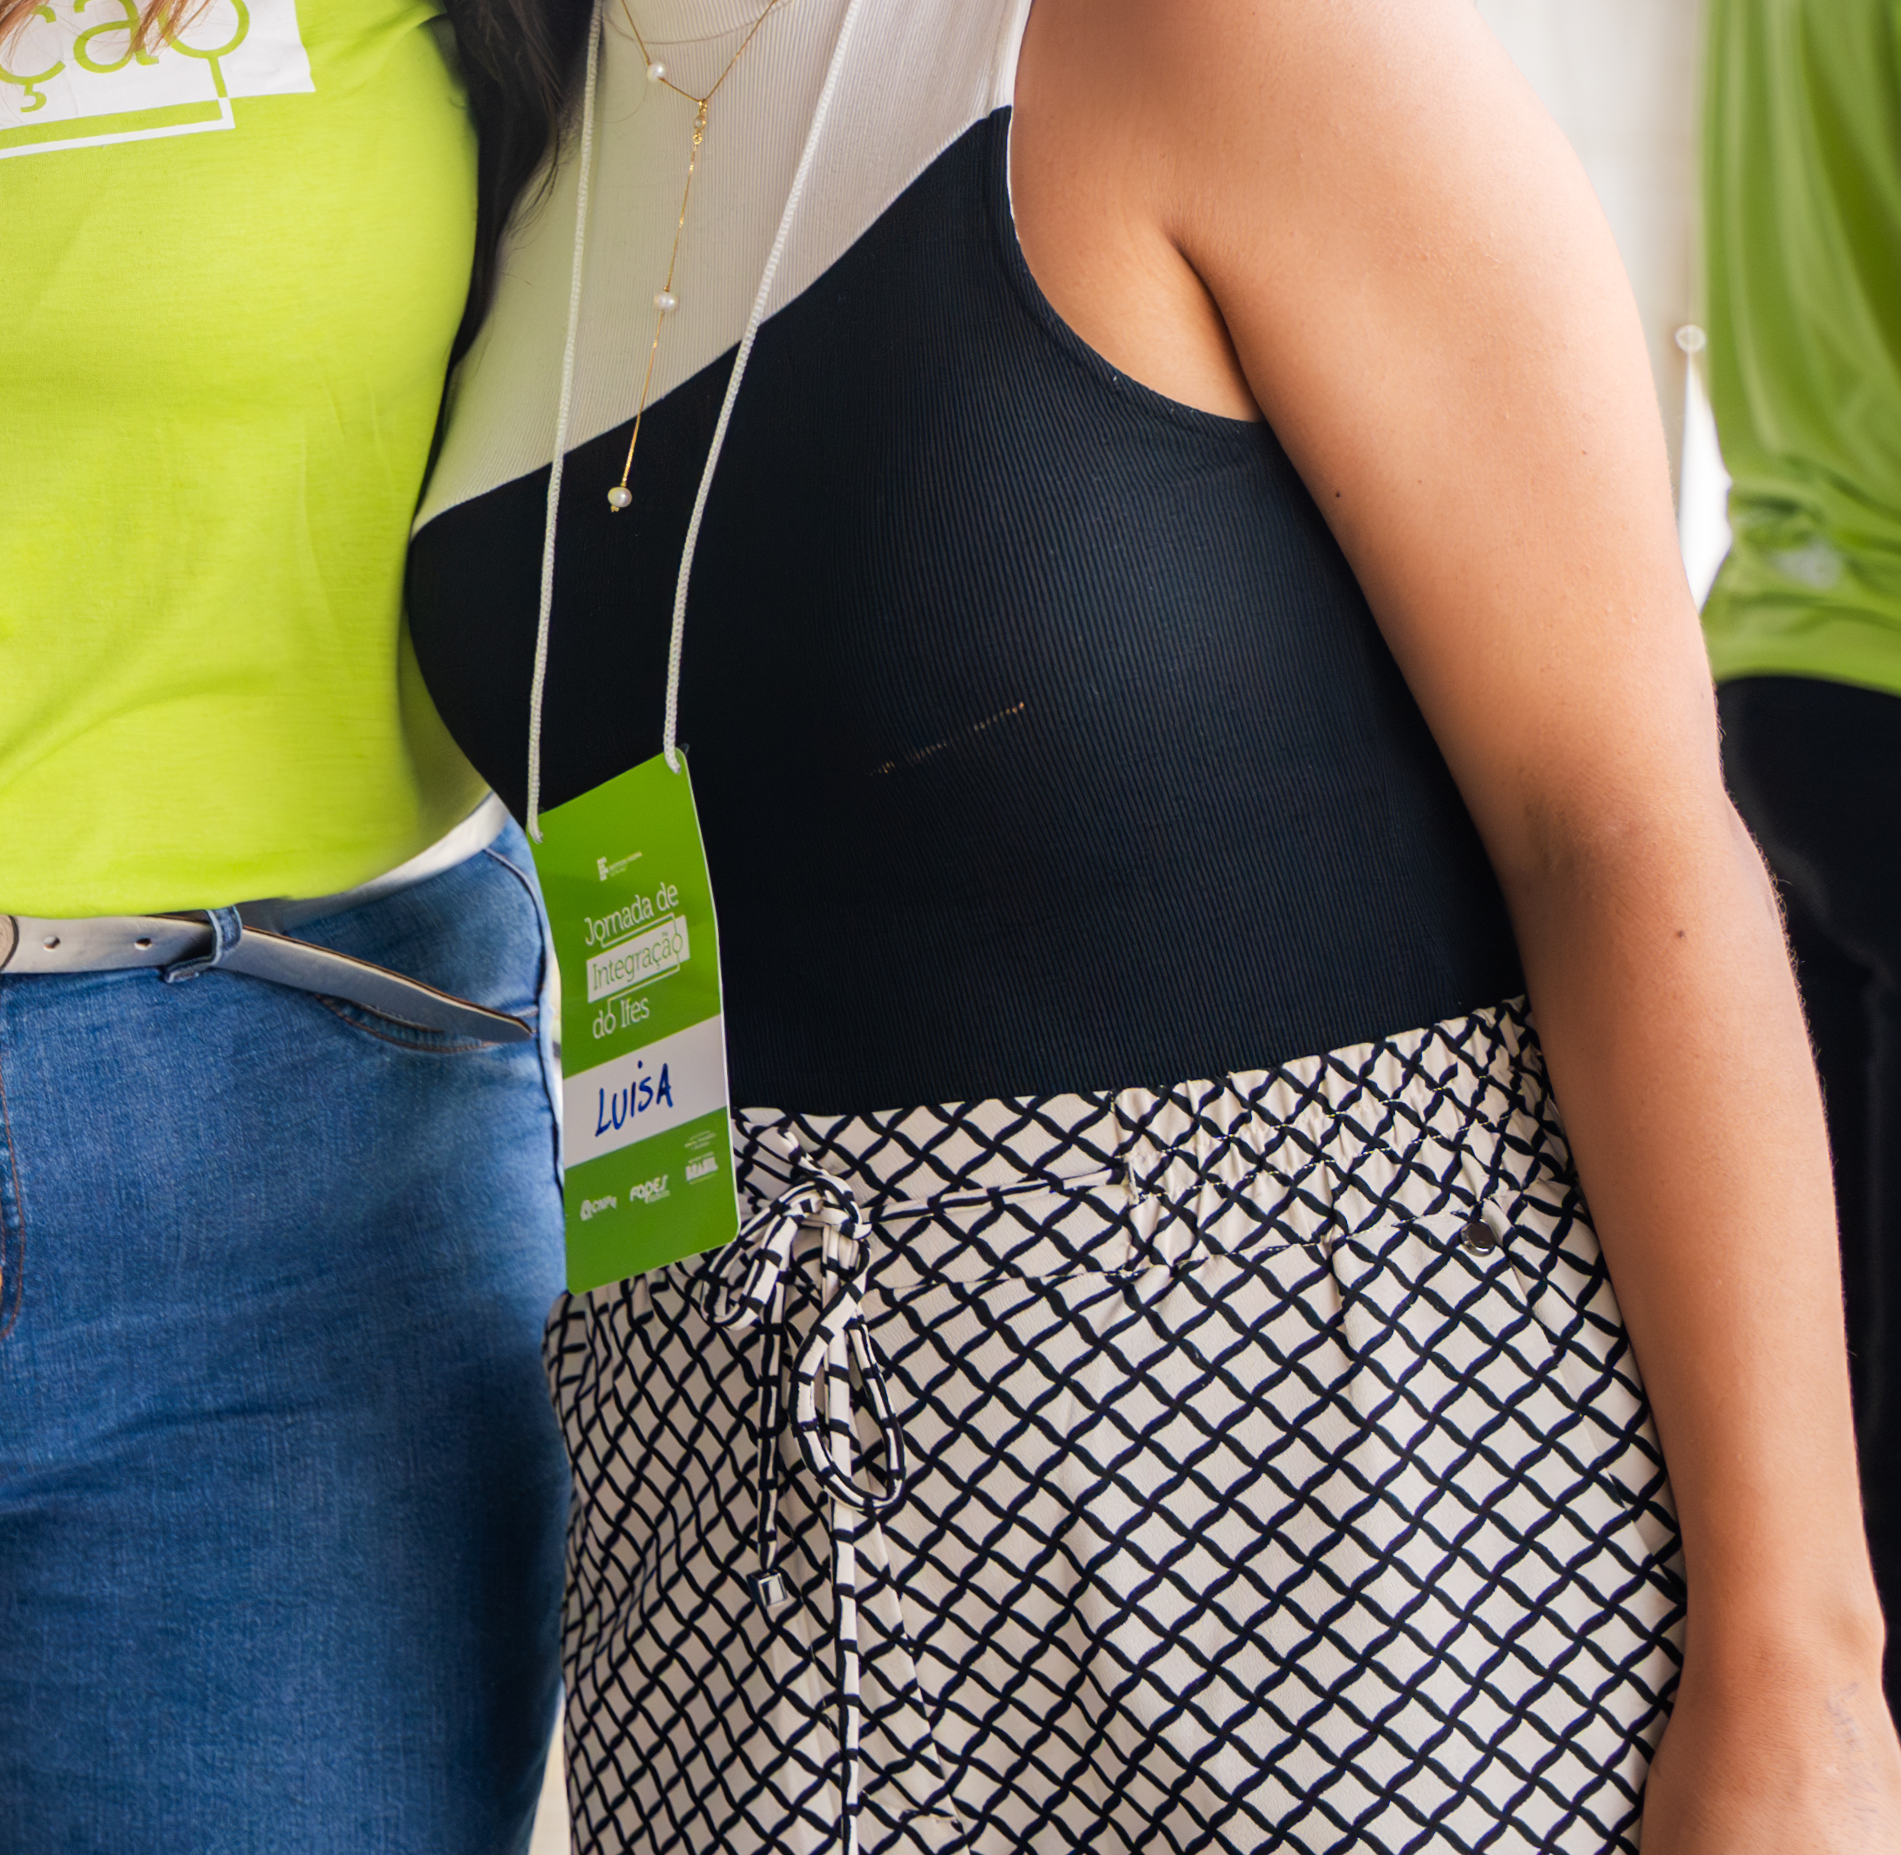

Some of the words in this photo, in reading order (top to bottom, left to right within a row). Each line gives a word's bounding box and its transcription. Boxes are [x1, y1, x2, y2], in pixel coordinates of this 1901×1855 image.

[584, 894, 654, 946] Jornada
[656, 882, 679, 911] de
[593, 930, 683, 991] Integração
[592, 1010, 616, 1039] do
[620, 997, 650, 1028] Ifes
